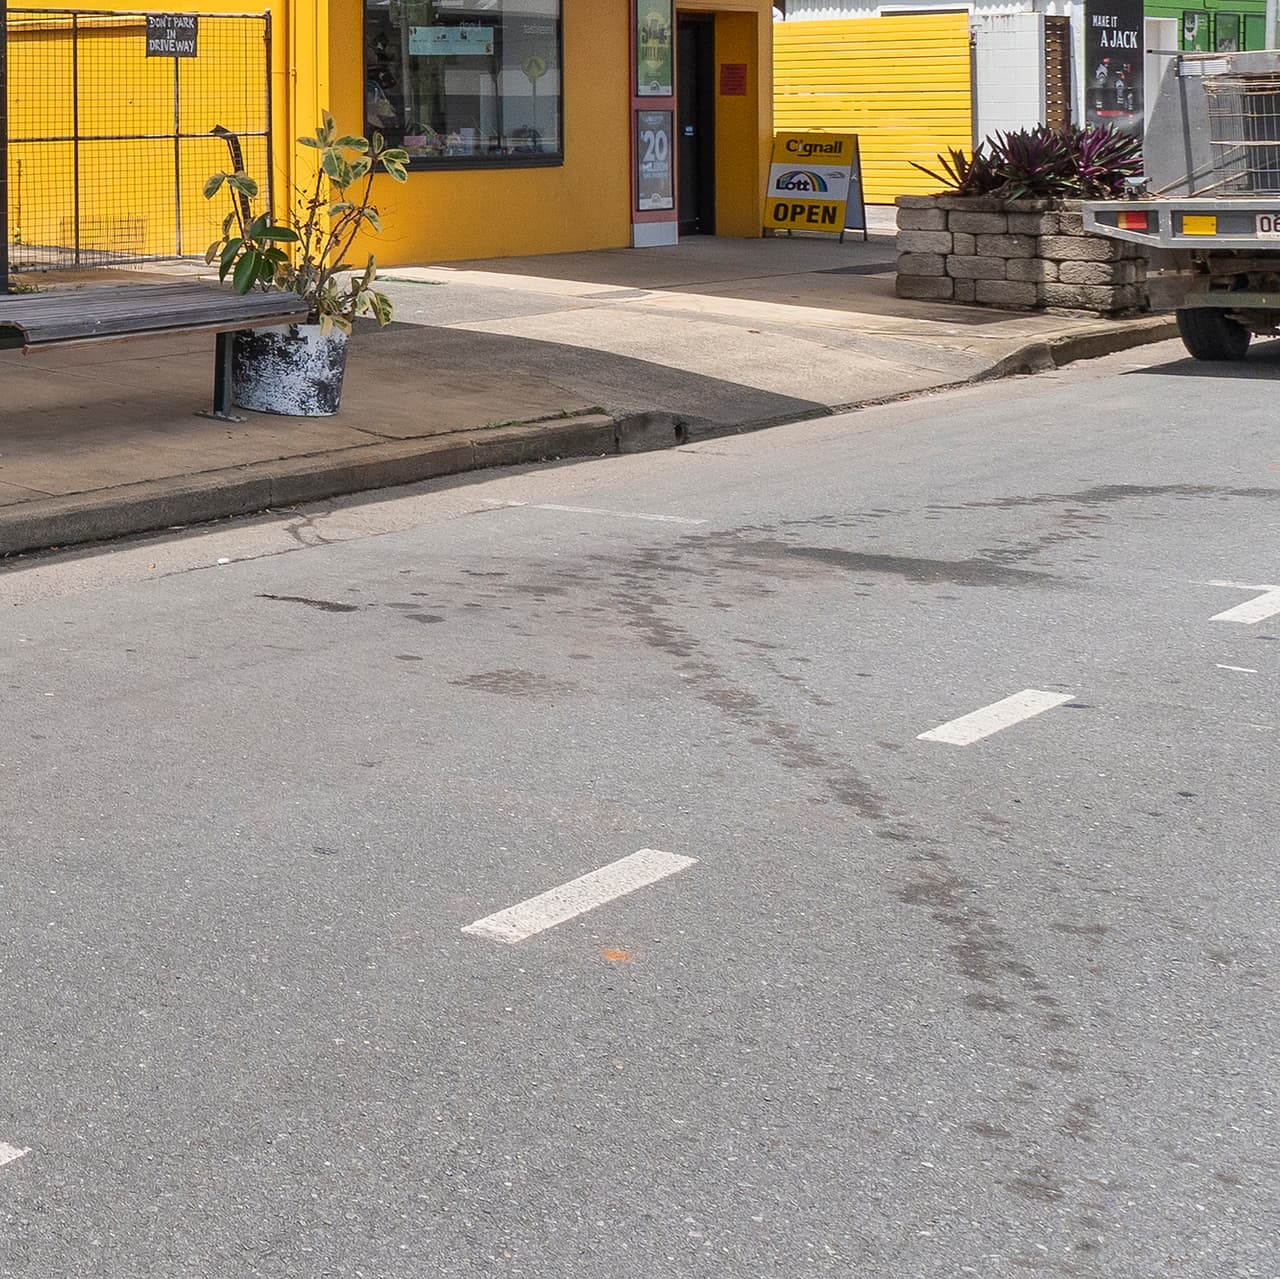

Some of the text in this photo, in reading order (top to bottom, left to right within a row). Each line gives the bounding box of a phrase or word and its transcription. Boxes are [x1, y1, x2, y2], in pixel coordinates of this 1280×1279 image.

[148, 15, 195, 28] DON'T PARK
[1092, 15, 1119, 28] MAKE IT
[166, 29, 176, 39] IN
[1100, 30, 1138, 49] A JACK
[148, 39, 195, 52] DRIVEWAY
[786, 139, 843, 157] Cignall
[776, 179, 810, 191] Lott
[773, 203, 838, 225] OPEN
